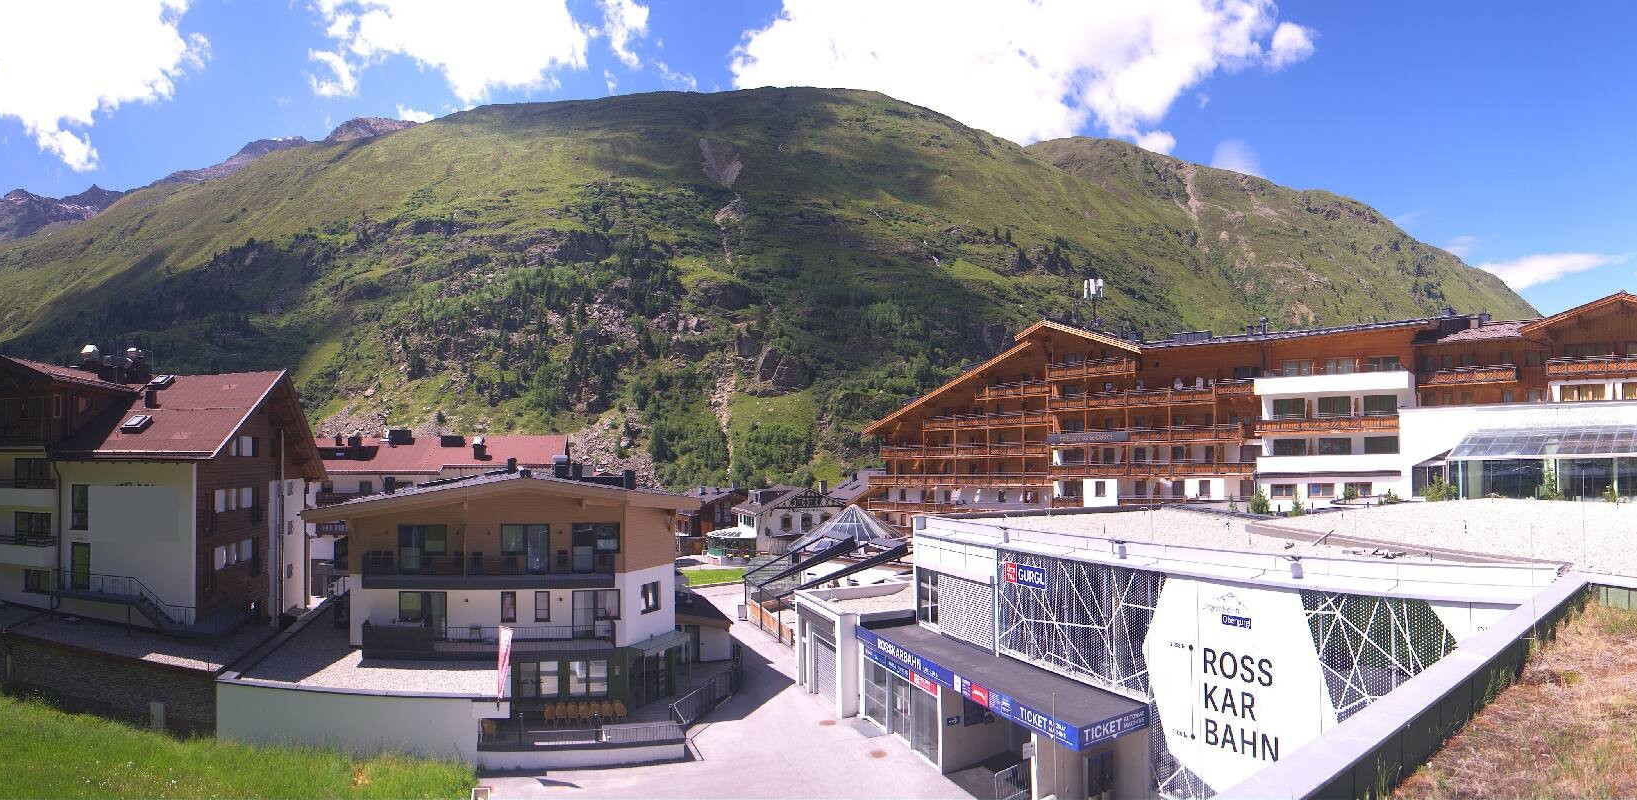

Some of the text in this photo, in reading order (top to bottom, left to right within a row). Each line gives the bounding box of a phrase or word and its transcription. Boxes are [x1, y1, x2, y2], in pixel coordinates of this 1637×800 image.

[1018, 568, 1045, 585] GURGL
[877, 638, 922, 670] ROSSKARBAHN
[1203, 647, 1273, 687] ROSS
[1019, 706, 1048, 730] TICKET
[1203, 682, 1257, 722] KAR
[1083, 717, 1123, 742] TICKET
[1204, 717, 1279, 763] BAHN
